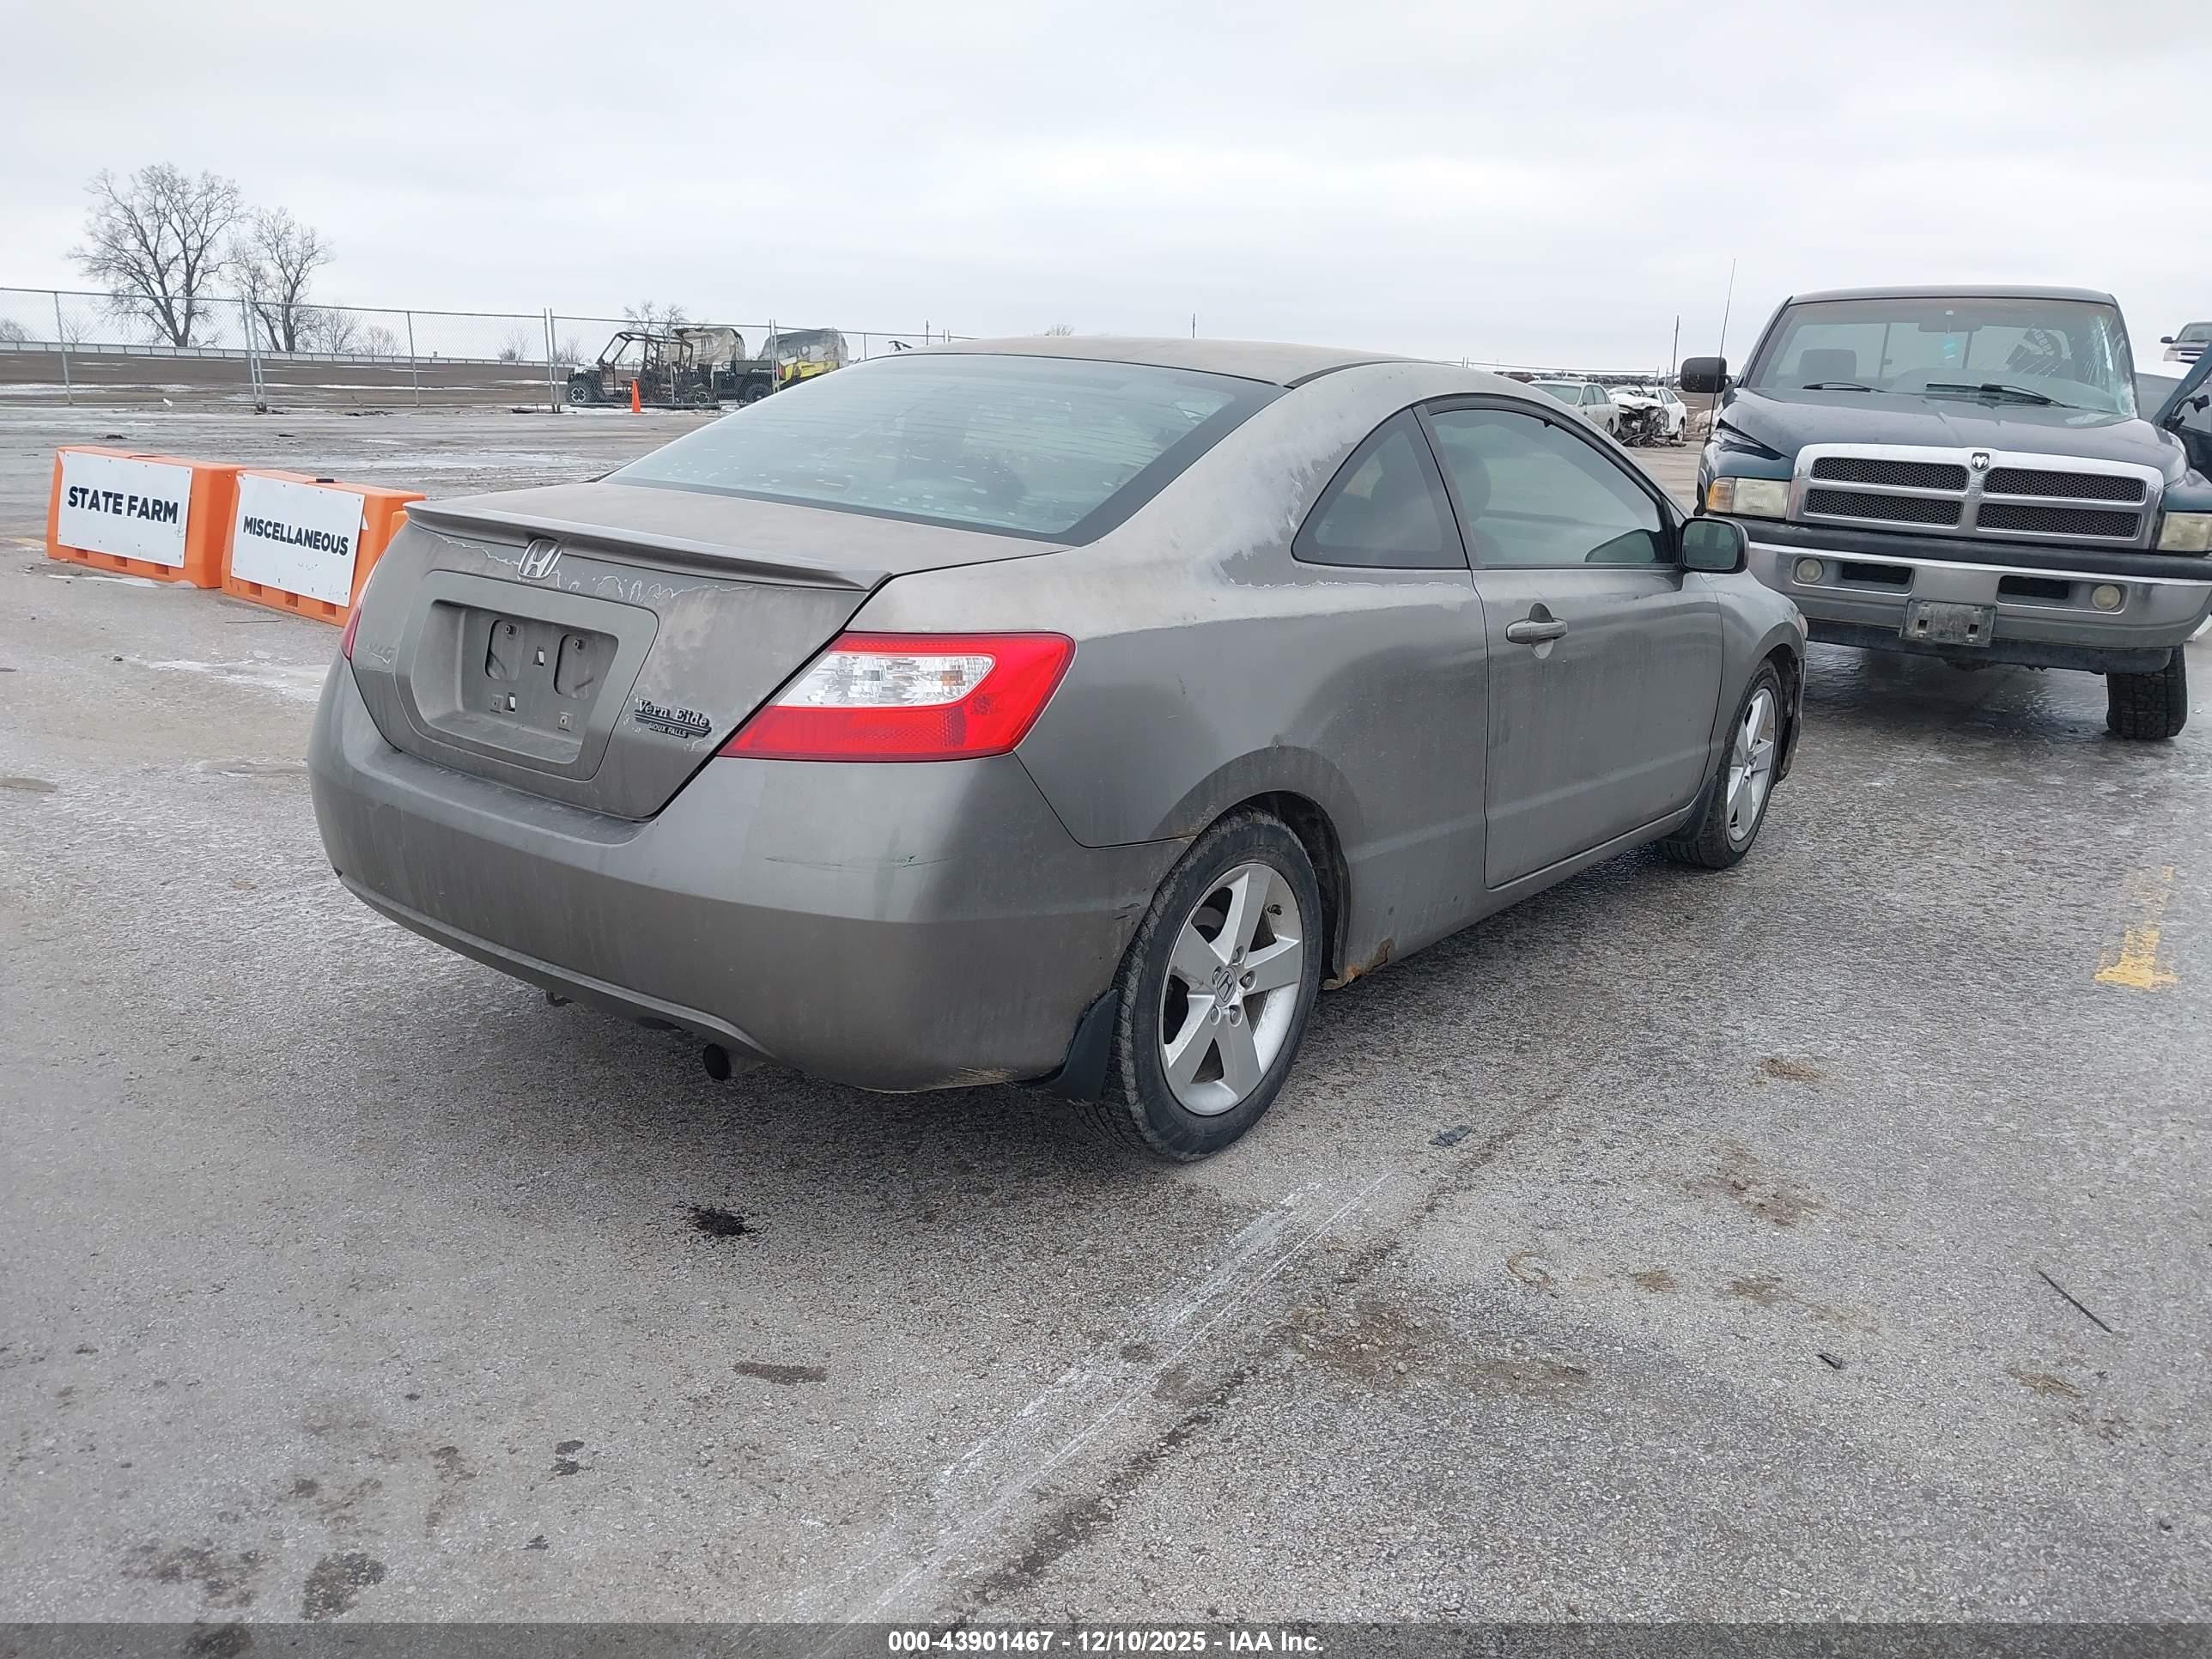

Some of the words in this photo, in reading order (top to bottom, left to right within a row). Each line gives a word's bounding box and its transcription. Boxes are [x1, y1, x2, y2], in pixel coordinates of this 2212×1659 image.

[68, 485, 124, 515] STATE
[126, 495, 179, 524] FARM
[243, 515, 349, 556] MISCELLANEOUS
[637, 698, 670, 719] Vern
[673, 708, 709, 727] Eide
[647, 722, 666, 733] SIOUX
[667, 726, 687, 738] FALLS
